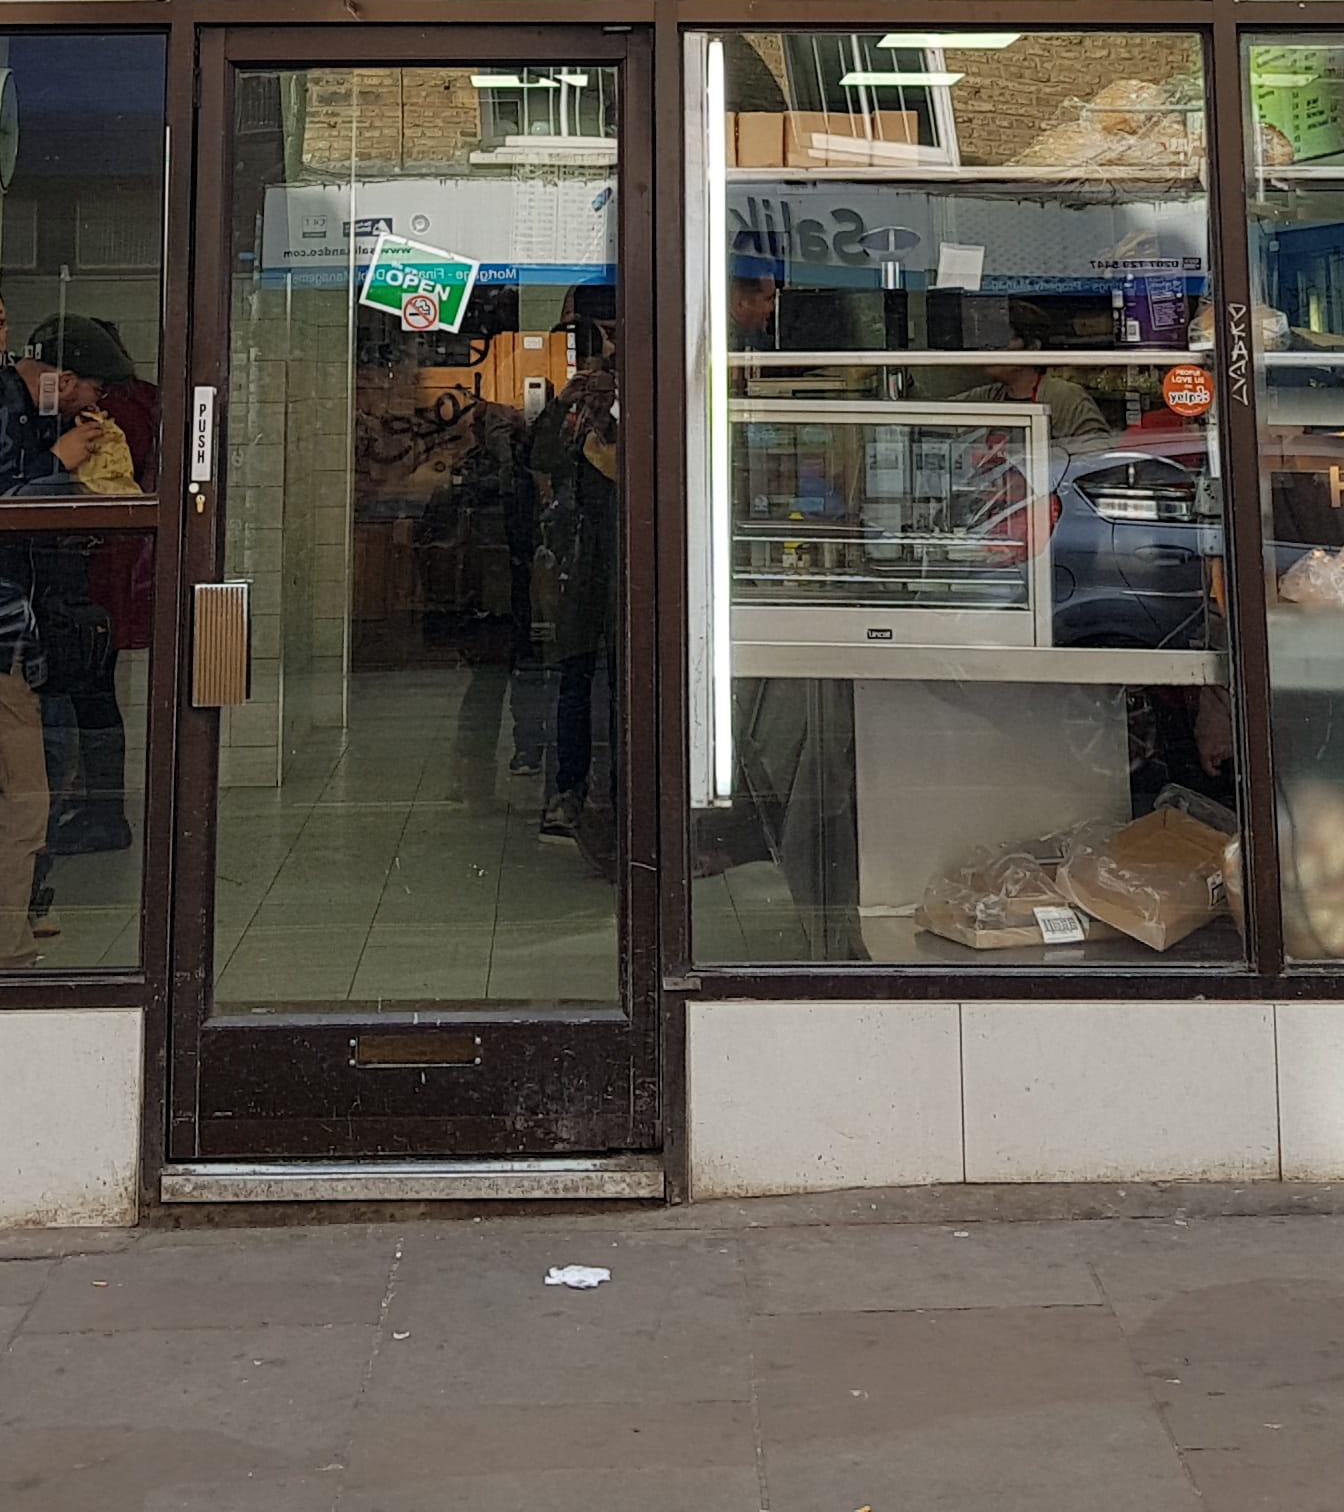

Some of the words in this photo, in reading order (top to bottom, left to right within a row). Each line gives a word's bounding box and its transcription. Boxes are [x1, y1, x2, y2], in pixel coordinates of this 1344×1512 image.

[385, 269, 451, 301] OPEN
[1169, 391, 1197, 405] yelp
[197, 403, 207, 464] PUSH
